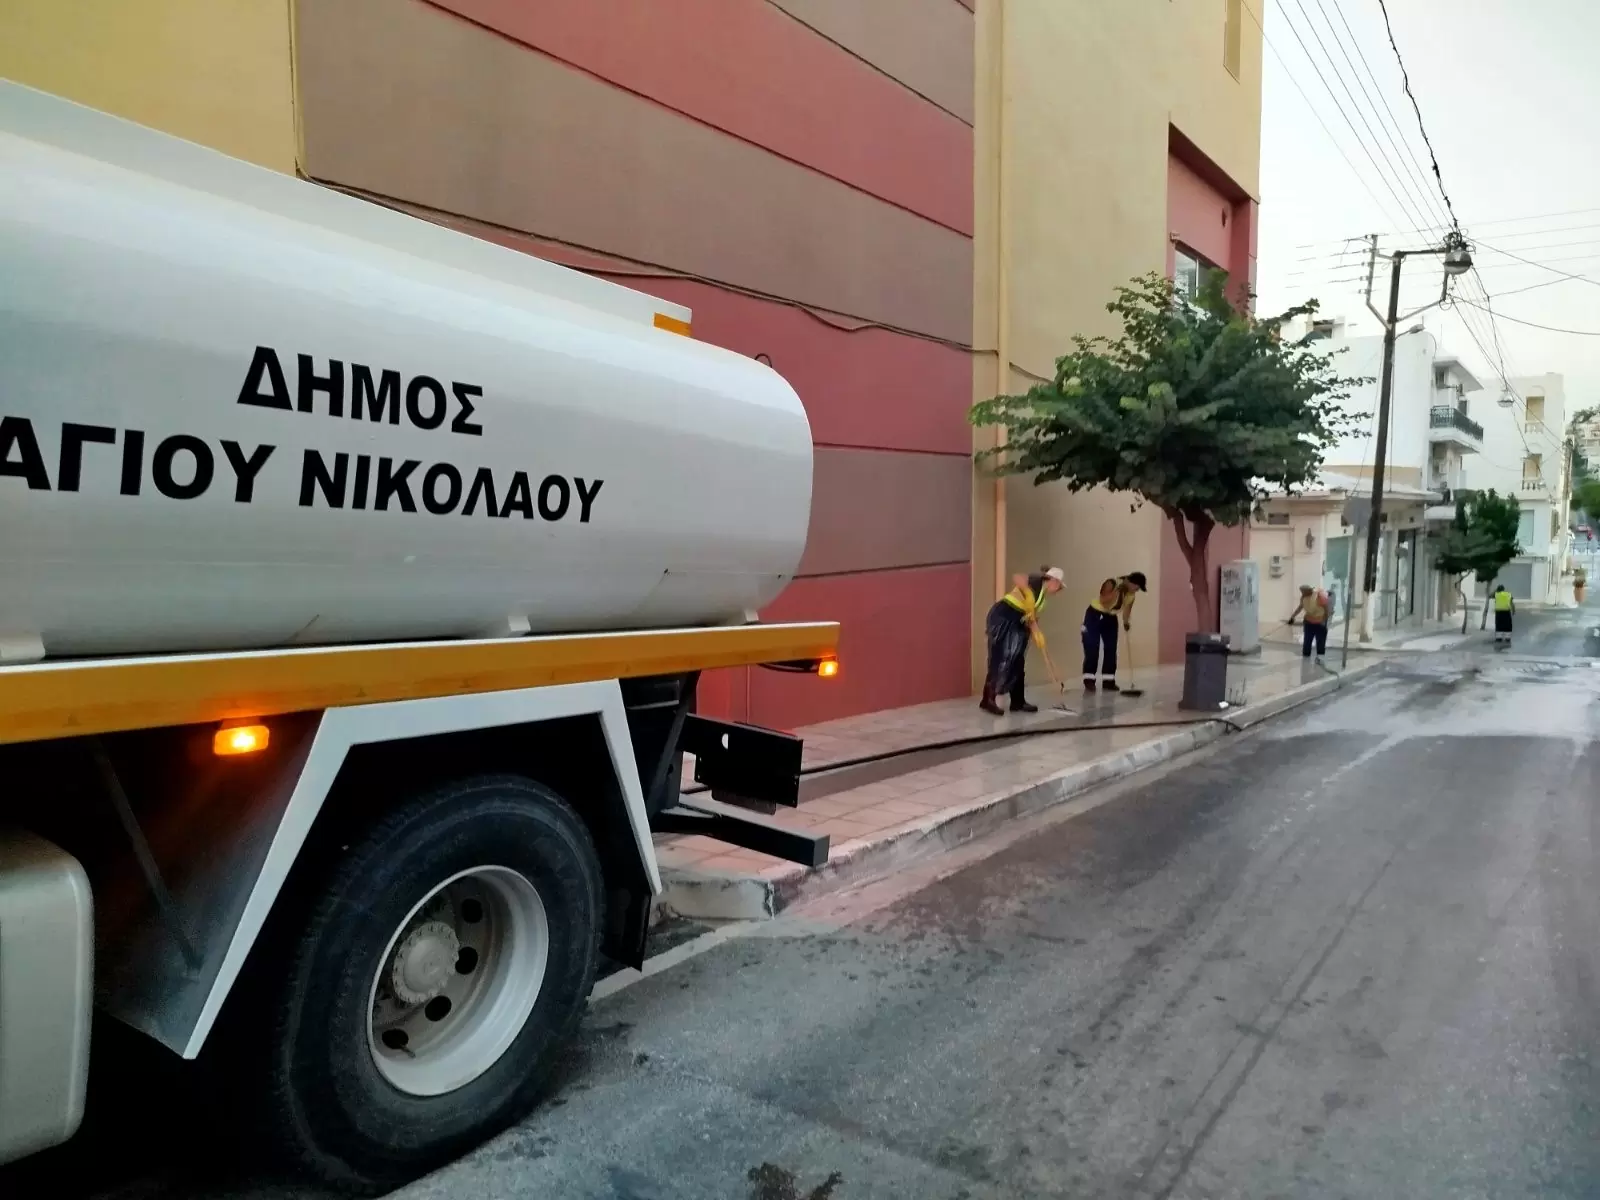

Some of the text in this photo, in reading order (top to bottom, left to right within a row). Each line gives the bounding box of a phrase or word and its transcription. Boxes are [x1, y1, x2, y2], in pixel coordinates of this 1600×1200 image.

[237, 346, 483, 437] ΔΗΜΟΣ
[0, 416, 605, 523] ΑΓΙΟΥ ΝΙΚΟΛΑΟΥ
